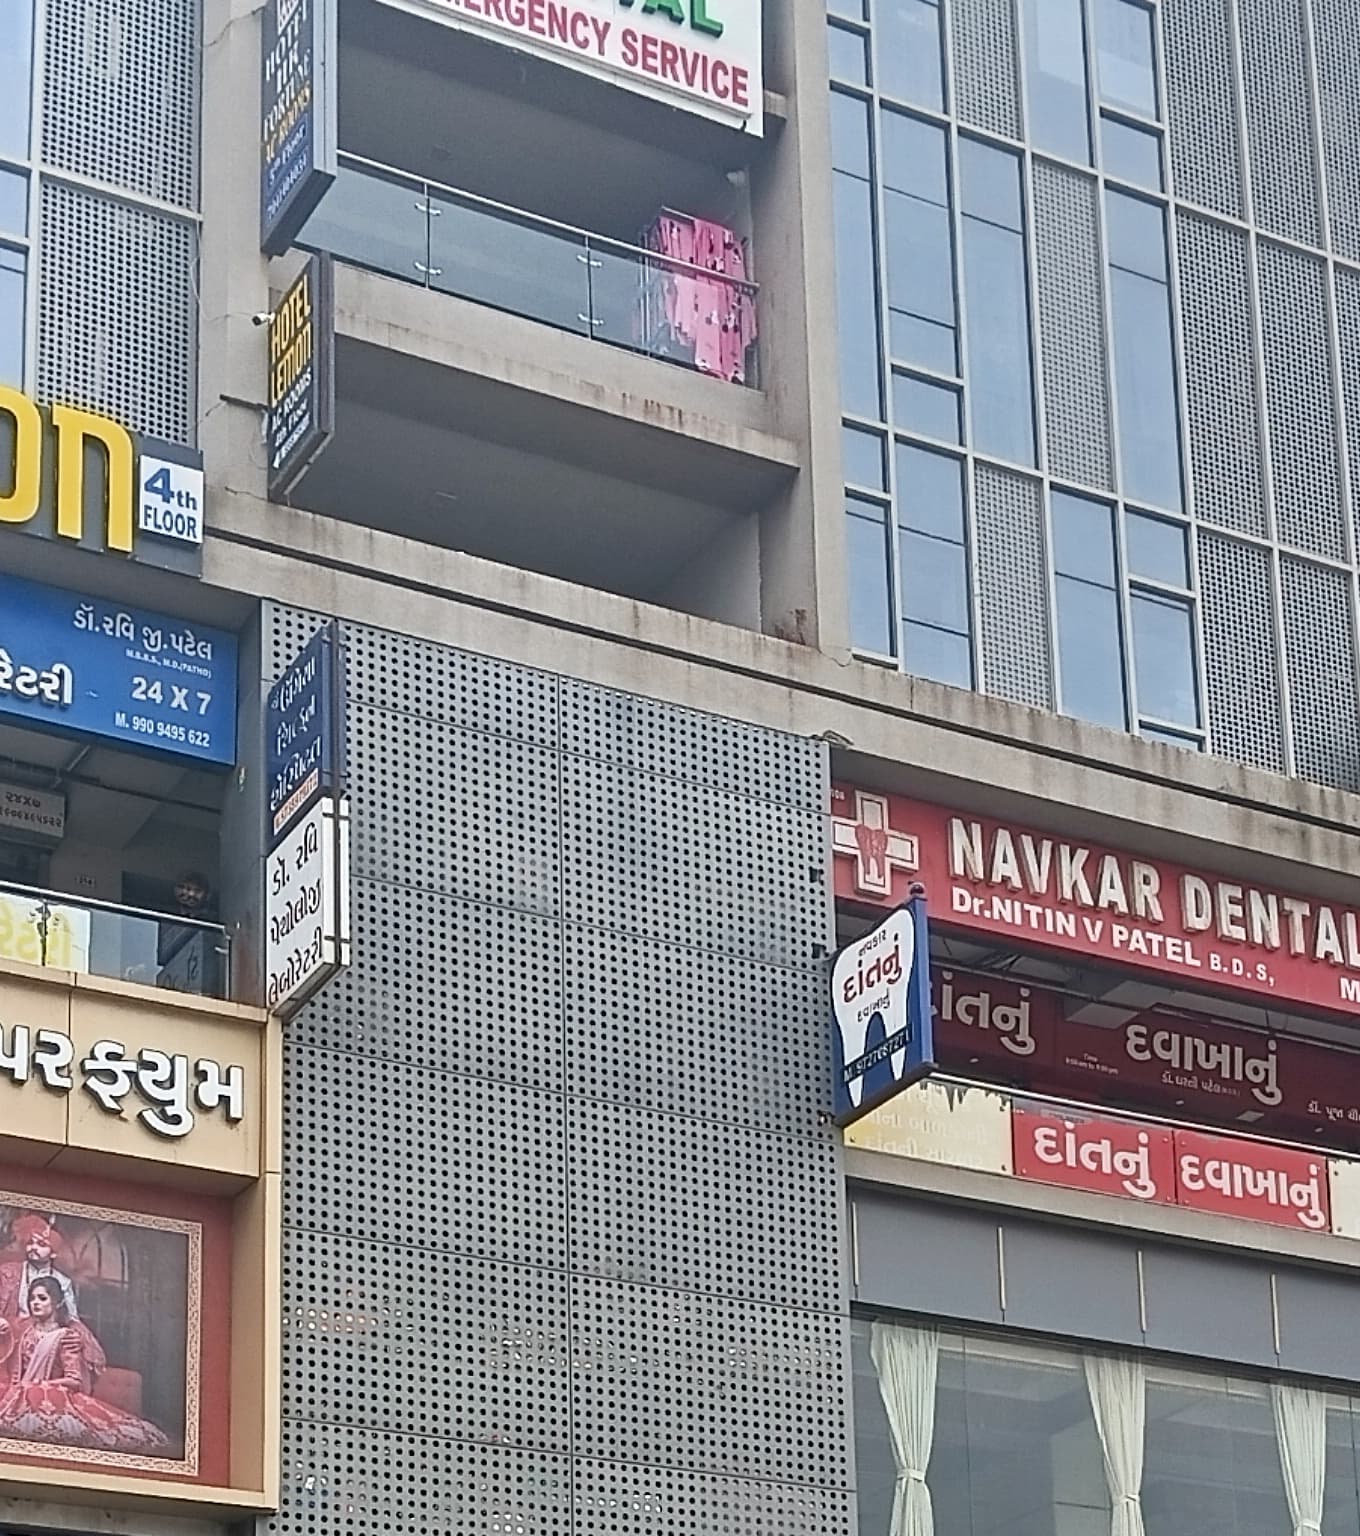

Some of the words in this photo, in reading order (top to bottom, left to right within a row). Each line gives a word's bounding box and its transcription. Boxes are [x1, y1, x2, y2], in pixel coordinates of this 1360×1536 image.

[621, 28, 750, 108] SERVICE
[271, 273, 311, 364] HOTEL
[142, 465, 199, 514] 4th
[142, 503, 198, 541] FLOOR
[131, 675, 163, 705] 24
[170, 684, 192, 711] X
[197, 690, 212, 716] 7
[132, 713, 154, 736] 990
[156, 718, 186, 742] 9495
[190, 725, 212, 748] 622
[296, 821, 319, 868] રવિ
[948, 815, 1163, 923] NAVKAR
[843, 932, 903, 1003] દાંતનું
[1082, 915, 1103, 945] V
[1111, 920, 1202, 969] PATEL
[1126, 1023, 1283, 1108] દવાખાનું
[1034, 1120, 1157, 1200] દાંતનું
[1179, 1151, 1327, 1231] દવાખાનું
